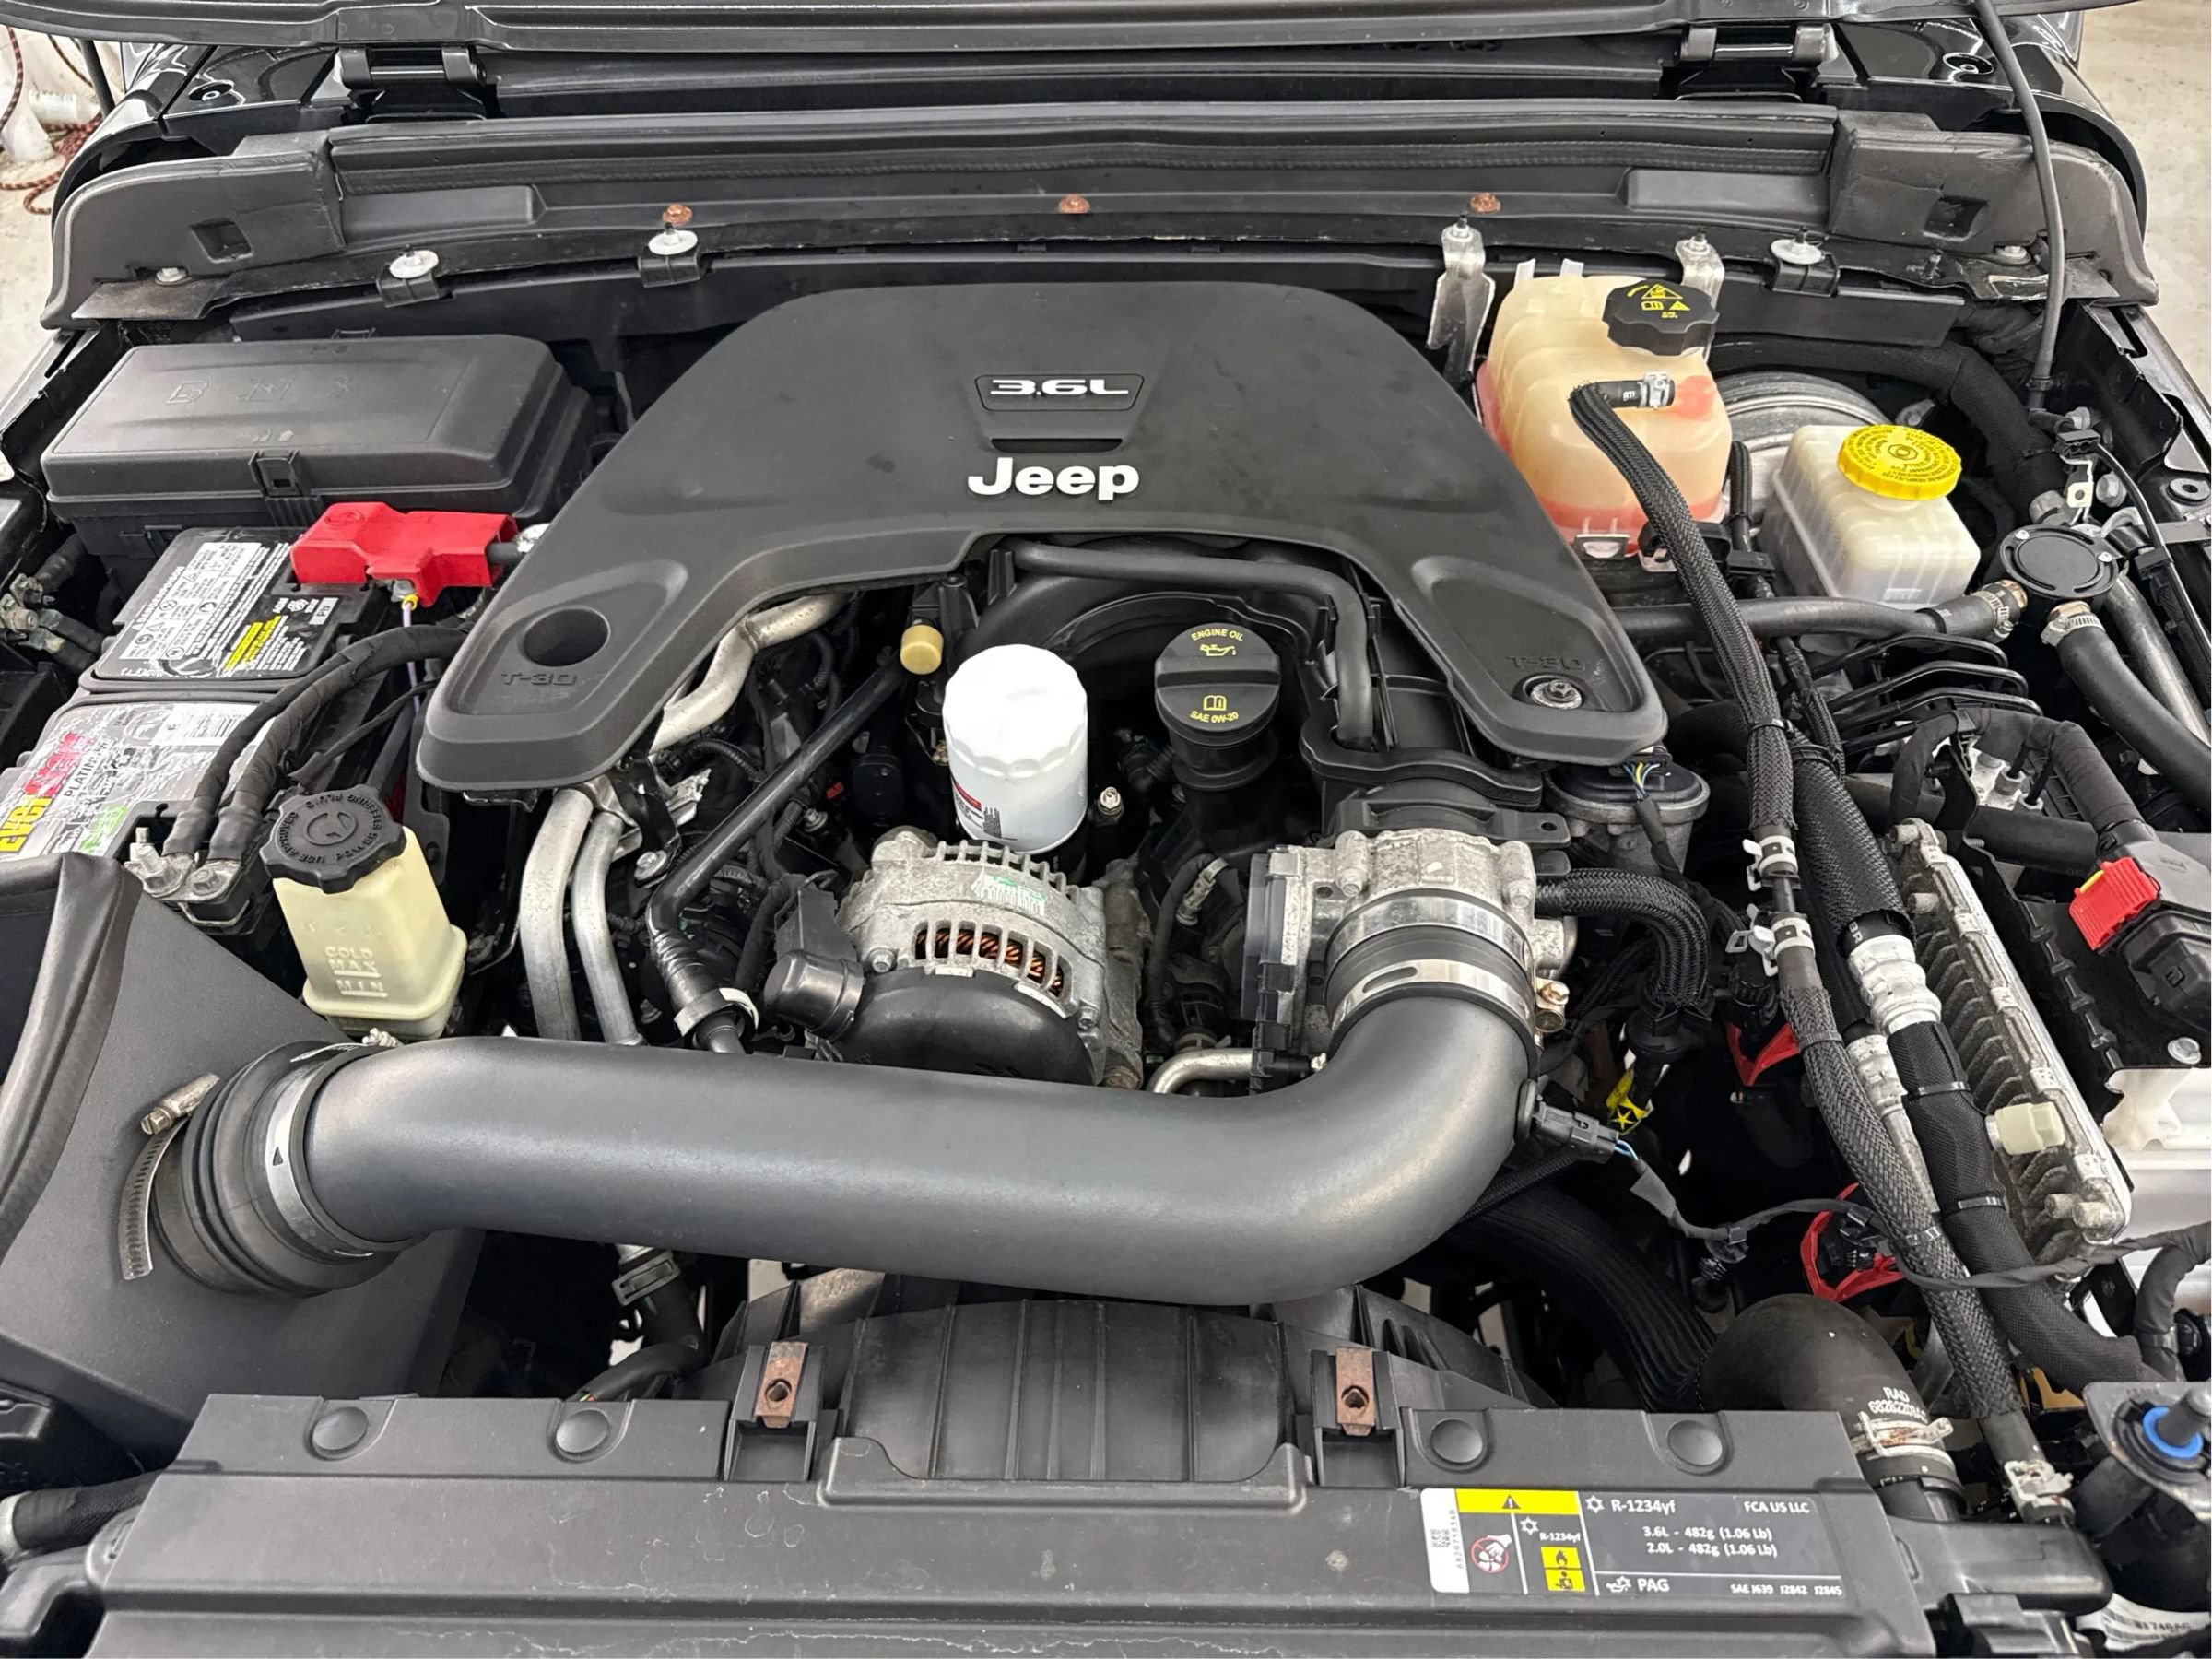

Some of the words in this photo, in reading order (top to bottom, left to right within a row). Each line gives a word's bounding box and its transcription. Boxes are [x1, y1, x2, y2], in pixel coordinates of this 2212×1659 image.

[990, 379, 1129, 395] 3.6L
[968, 457, 1139, 500] Jeep
[1191, 629, 1228, 641] ENGINE
[1229, 630, 1243, 641] OIL
[500, 673, 578, 686] T-30
[1190, 710, 1210, 723] SAE
[1211, 711, 1239, 723] 0W-20
[325, 947, 373, 959] COLD
[328, 959, 378, 973] MAX
[336, 980, 383, 992] MIN
[1883, 1387, 1910, 1403] RAD
[1611, 1500, 1676, 1515] R-1234yf
[1744, 1501, 1767, 1512] FCA
[1770, 1502, 1788, 1512] US
[1789, 1502, 1809, 1513] LLC
[1540, 1533, 1581, 1544] R-1234yf
[1642, 1526, 1669, 1537] 3.6L
[1685, 1527, 1715, 1540] 482g
[1720, 1527, 1750, 1540] (1.06
[1753, 1528, 1772, 1541] Lb)
[1647, 1543, 1674, 1554] 2.0L
[1688, 1544, 1720, 1557] 482g
[1724, 1544, 1755, 1556] (1.06
[1758, 1545, 1777, 1558] Lb)
[1637, 1579, 1669, 1592] PAG
[1731, 1584, 1749, 1594] SAE
